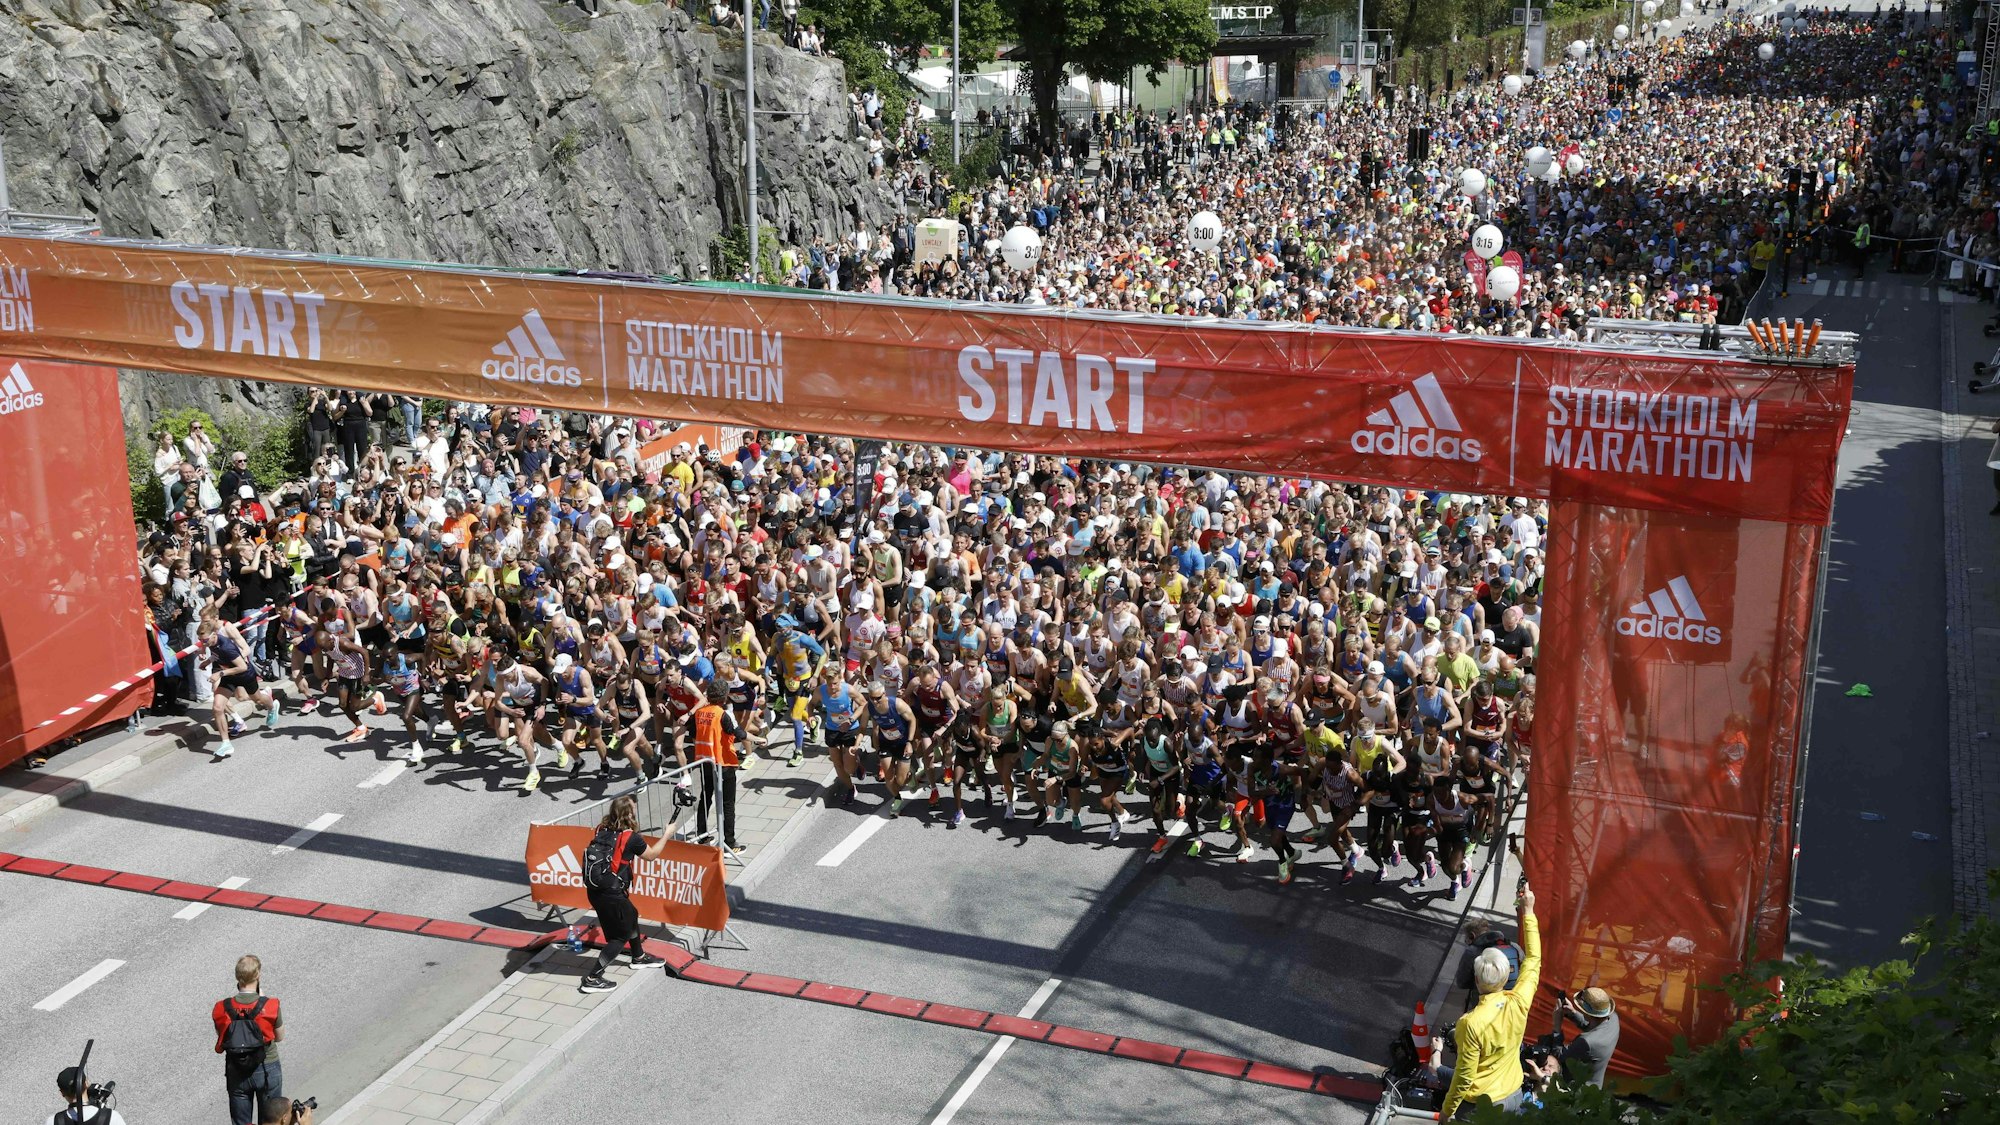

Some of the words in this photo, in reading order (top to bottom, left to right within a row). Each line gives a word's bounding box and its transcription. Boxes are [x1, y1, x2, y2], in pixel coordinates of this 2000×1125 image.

[1193, 227, 1214, 239] 3:00
[1476, 237, 1493, 249] 3:15
[170, 281, 325, 360] START
[625, 319, 783, 366] STOCKHOLM
[481, 355, 582, 387] adidas
[626, 355, 783, 404] MARATHON
[957, 344, 1156, 434] START
[1547, 385, 1758, 441] STOCKHOLM
[1350, 426, 1482, 463] adidas
[1544, 427, 1752, 483] MARATHON
[856, 462, 872, 476] 3:00
[1616, 614, 1722, 645] adidas
[529, 870, 588, 888] adida
[630, 854, 707, 887] TOCKHOLM
